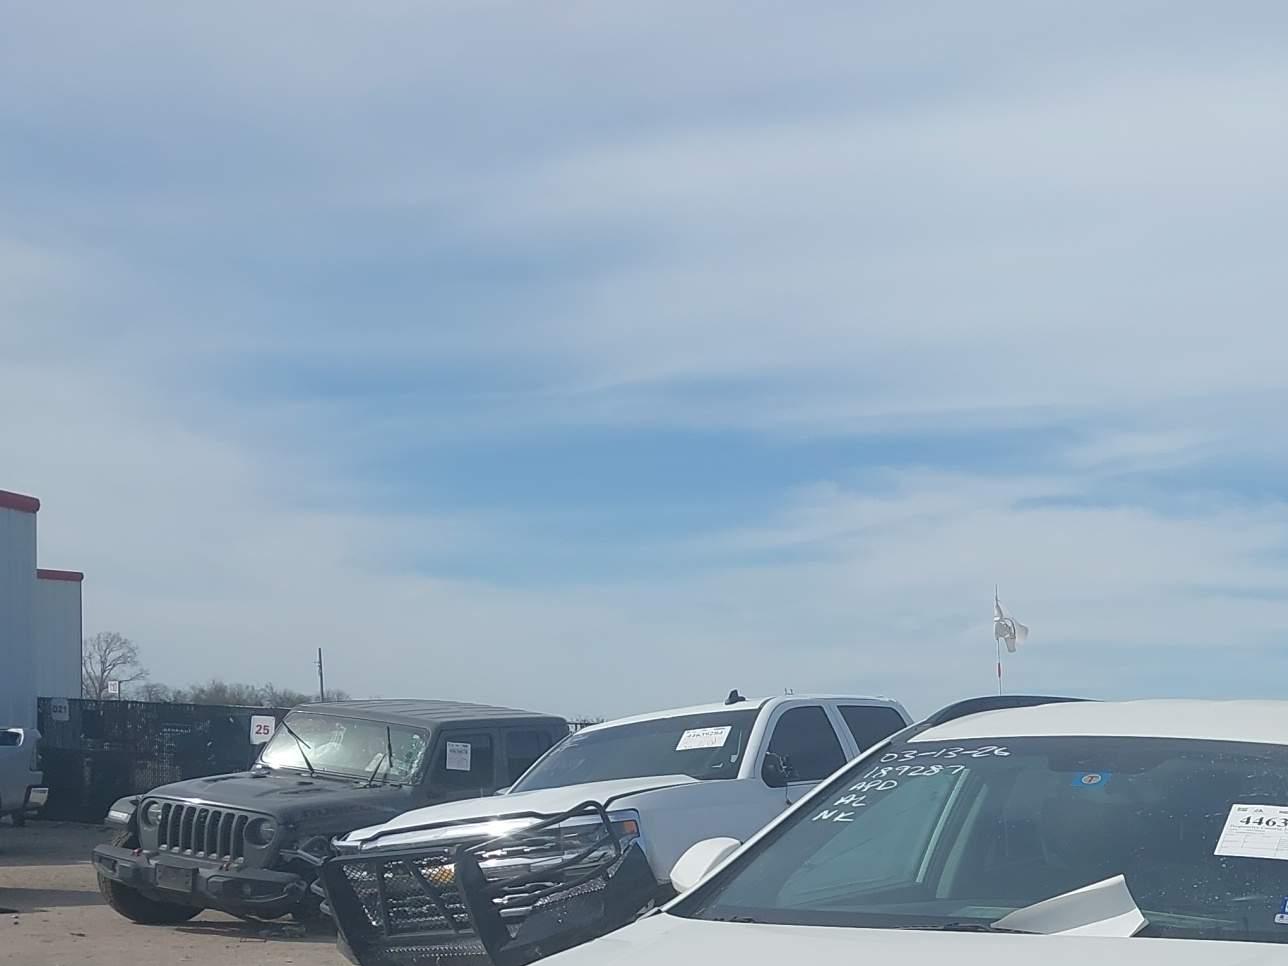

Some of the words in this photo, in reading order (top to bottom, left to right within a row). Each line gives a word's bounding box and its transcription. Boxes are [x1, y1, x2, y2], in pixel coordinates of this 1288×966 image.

[255, 724, 270, 735] 25
[880, 745, 1011, 763] 03-13-26
[863, 764, 966, 779] 189287
[812, 809, 855, 822] NK
